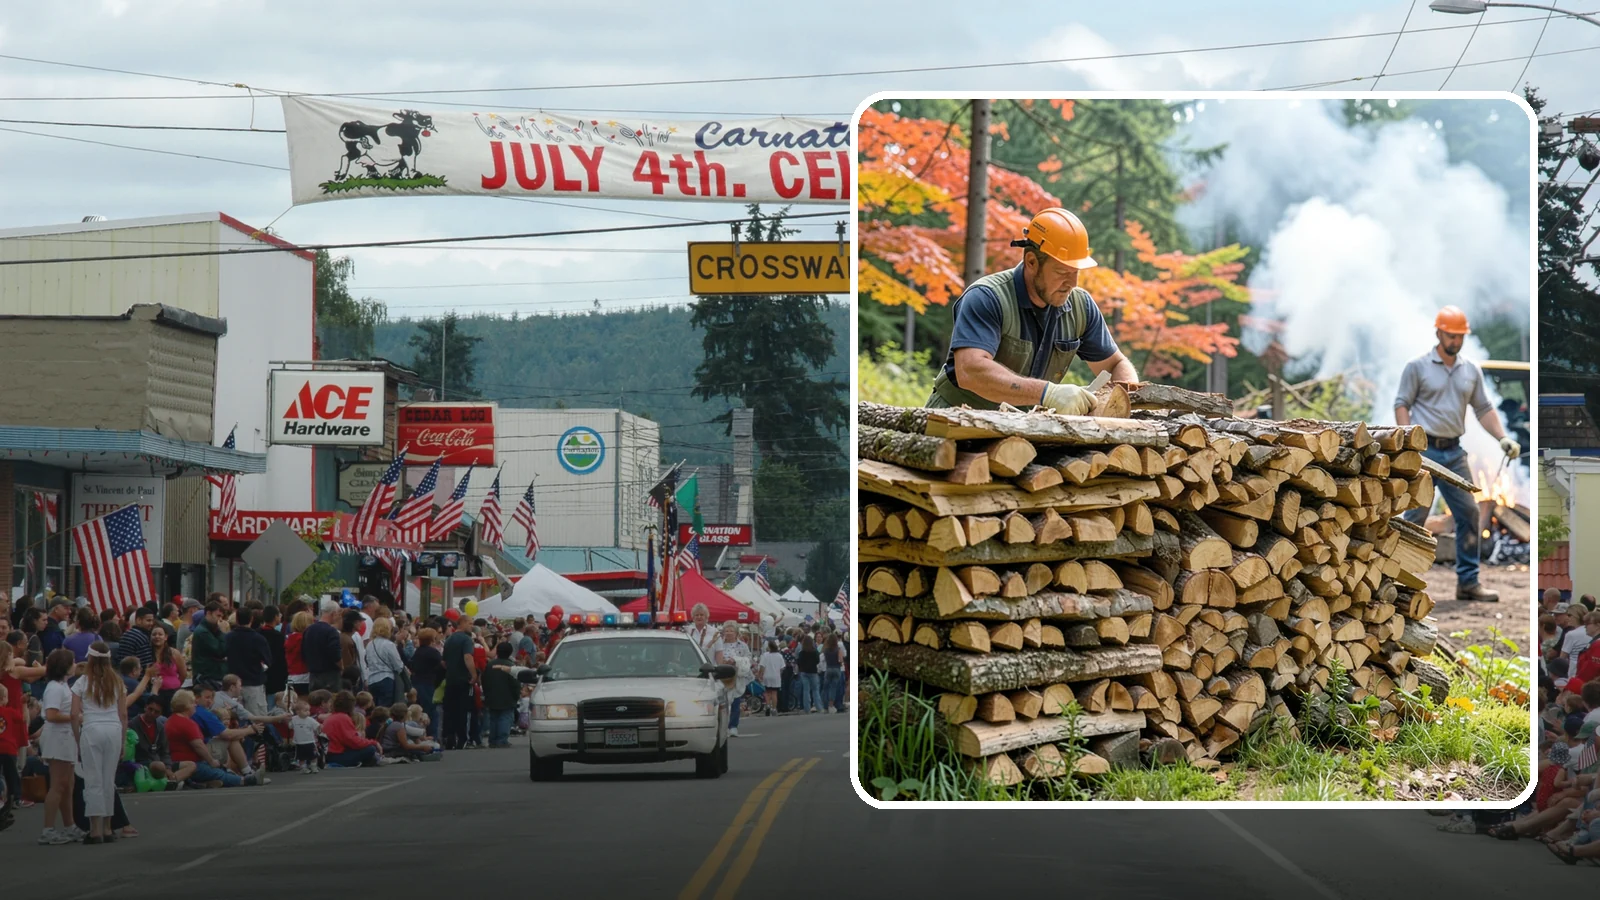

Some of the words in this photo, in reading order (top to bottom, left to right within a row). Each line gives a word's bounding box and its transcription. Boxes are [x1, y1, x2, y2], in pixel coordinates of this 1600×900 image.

[481, 141, 605, 192] JULY
[632, 150, 746, 198] 4th.
[697, 254, 850, 280] CROSSWA
[283, 380, 373, 419] ACE
[405, 409, 452, 421] CEDAR
[283, 421, 370, 436] Hardware
[416, 428, 477, 447] Coca-Cola
[353, 467, 385, 481] Simpl
[95, 485, 124, 495] Vincent
[126, 486, 136, 494] de
[138, 486, 155, 495] Paul
[688, 527, 741, 535] CRNATION
[699, 535, 730, 543] GLASS
